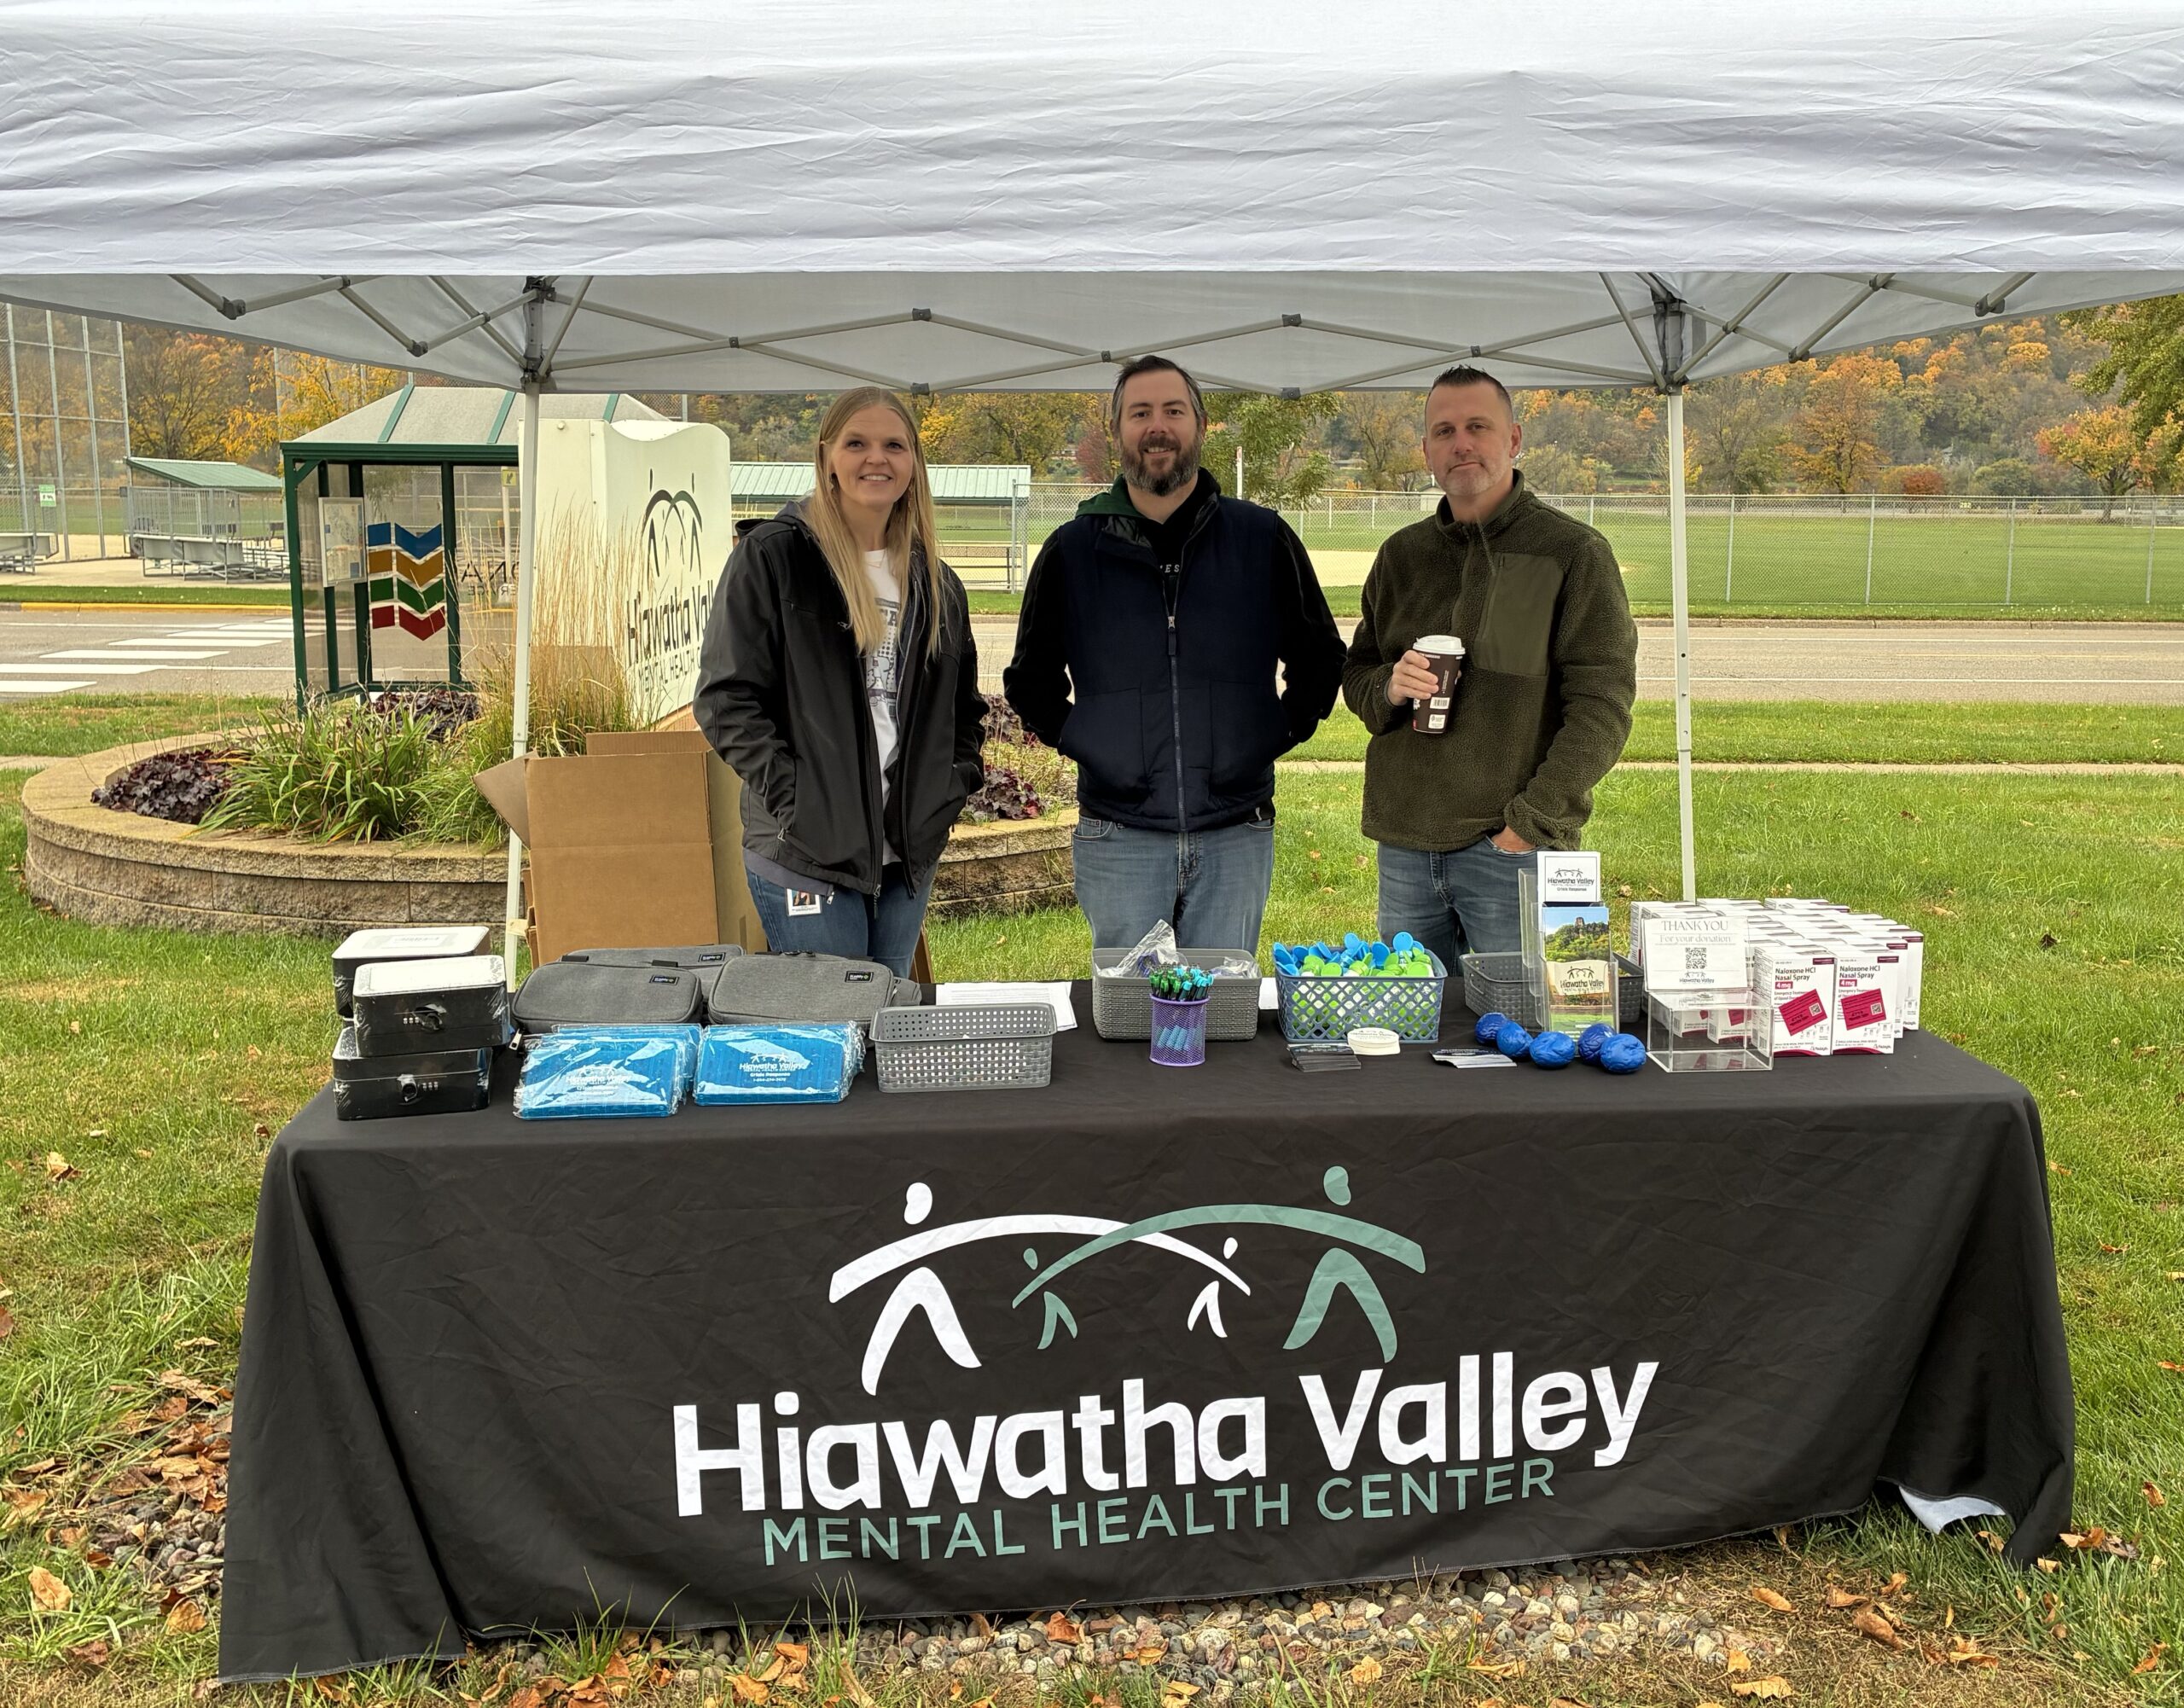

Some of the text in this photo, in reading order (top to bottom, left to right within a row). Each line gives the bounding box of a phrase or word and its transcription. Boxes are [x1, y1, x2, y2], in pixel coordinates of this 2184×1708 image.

[1160, 564, 1180, 573] ES
[627, 579, 716, 667] Hiawatha Vall
[1661, 921, 1728, 931] THANK YOU
[1660, 934, 1674, 943] For
[1695, 933, 1731, 943] donation
[1560, 979, 1605, 989] Hiawatha Valley
[673, 1351, 1659, 1516] Hiawatha Valley
[763, 1457, 1554, 1566] MENTAL HEALTH CENTER
